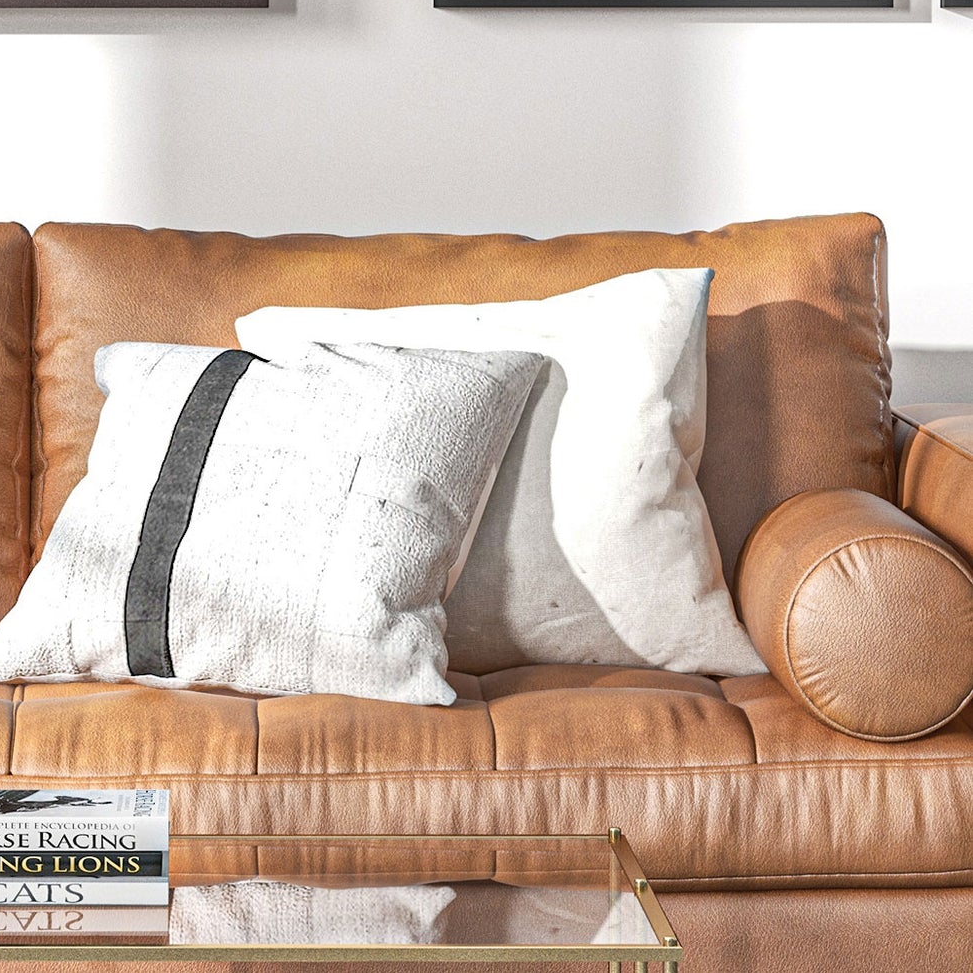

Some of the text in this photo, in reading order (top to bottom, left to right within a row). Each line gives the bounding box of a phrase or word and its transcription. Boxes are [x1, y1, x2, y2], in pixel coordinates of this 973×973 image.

[34, 822, 120, 831] ENCYCLOPEDIA
[38, 831, 136, 850] RACING
[52, 855, 141, 873] LIONS
